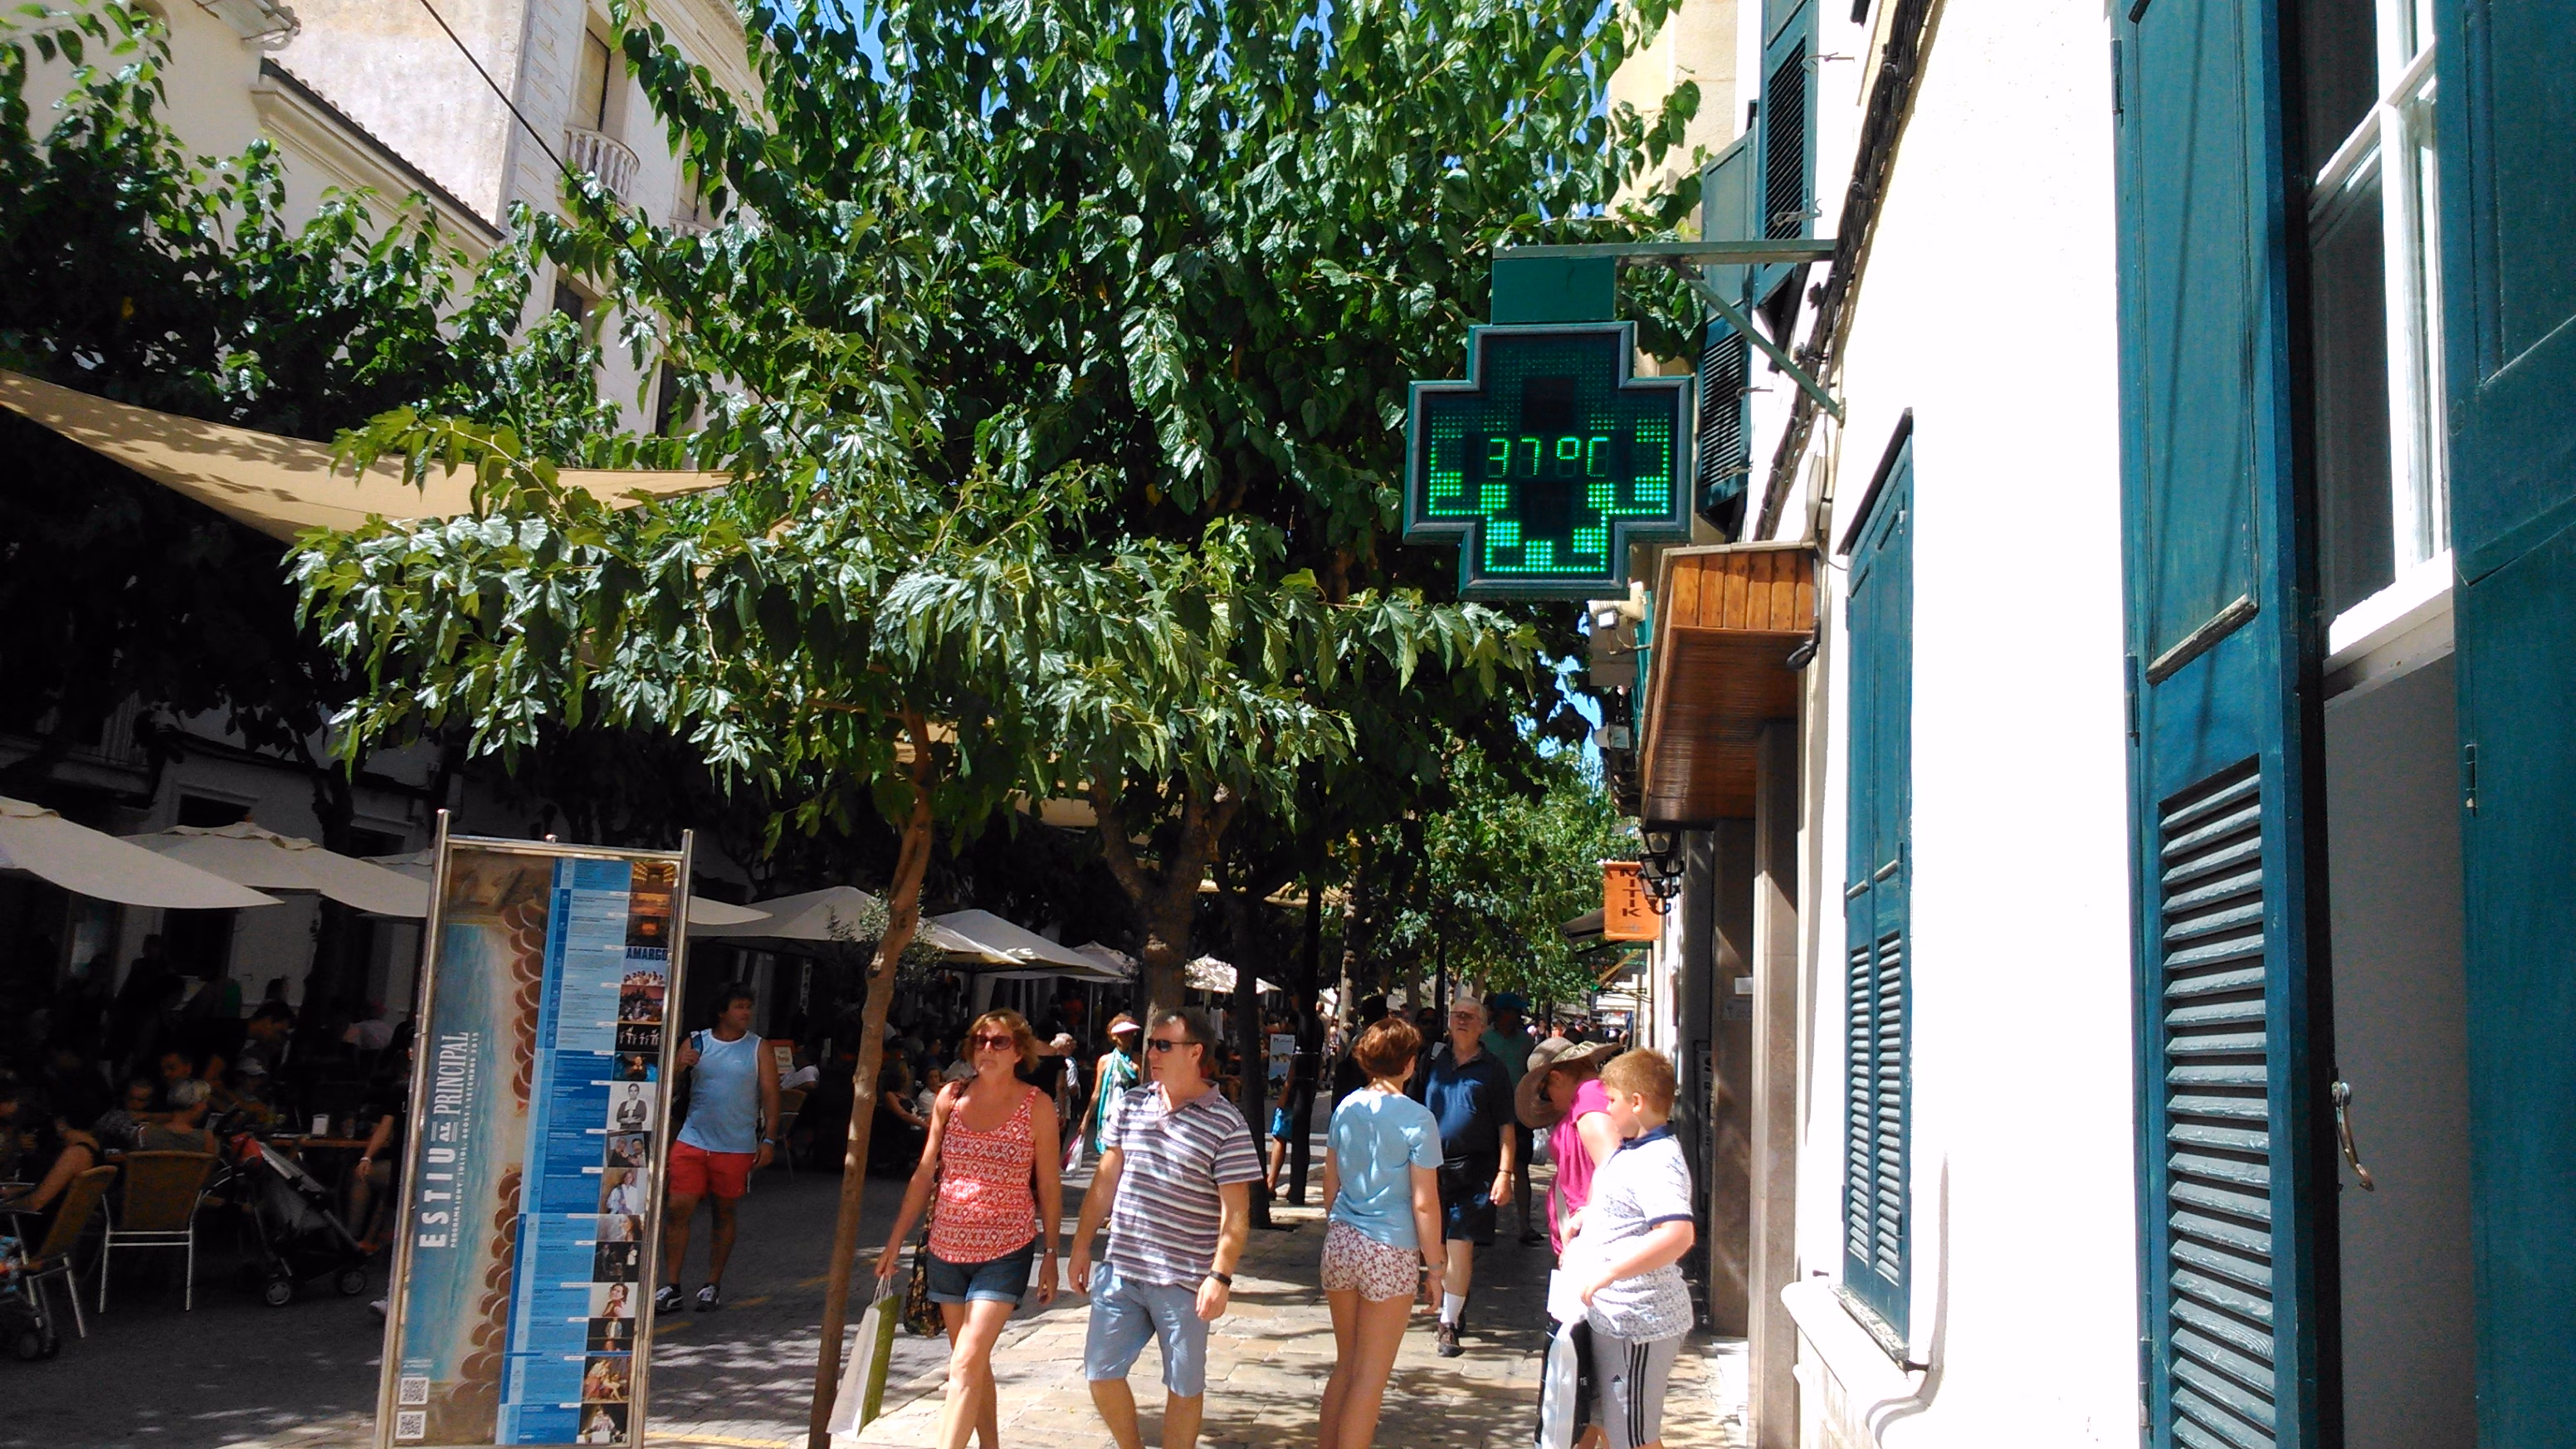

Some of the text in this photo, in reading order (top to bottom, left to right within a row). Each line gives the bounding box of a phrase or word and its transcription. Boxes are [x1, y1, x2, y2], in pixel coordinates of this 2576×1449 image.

[418, 1032, 469, 1247] ESTIU AL PRINCIPAL
